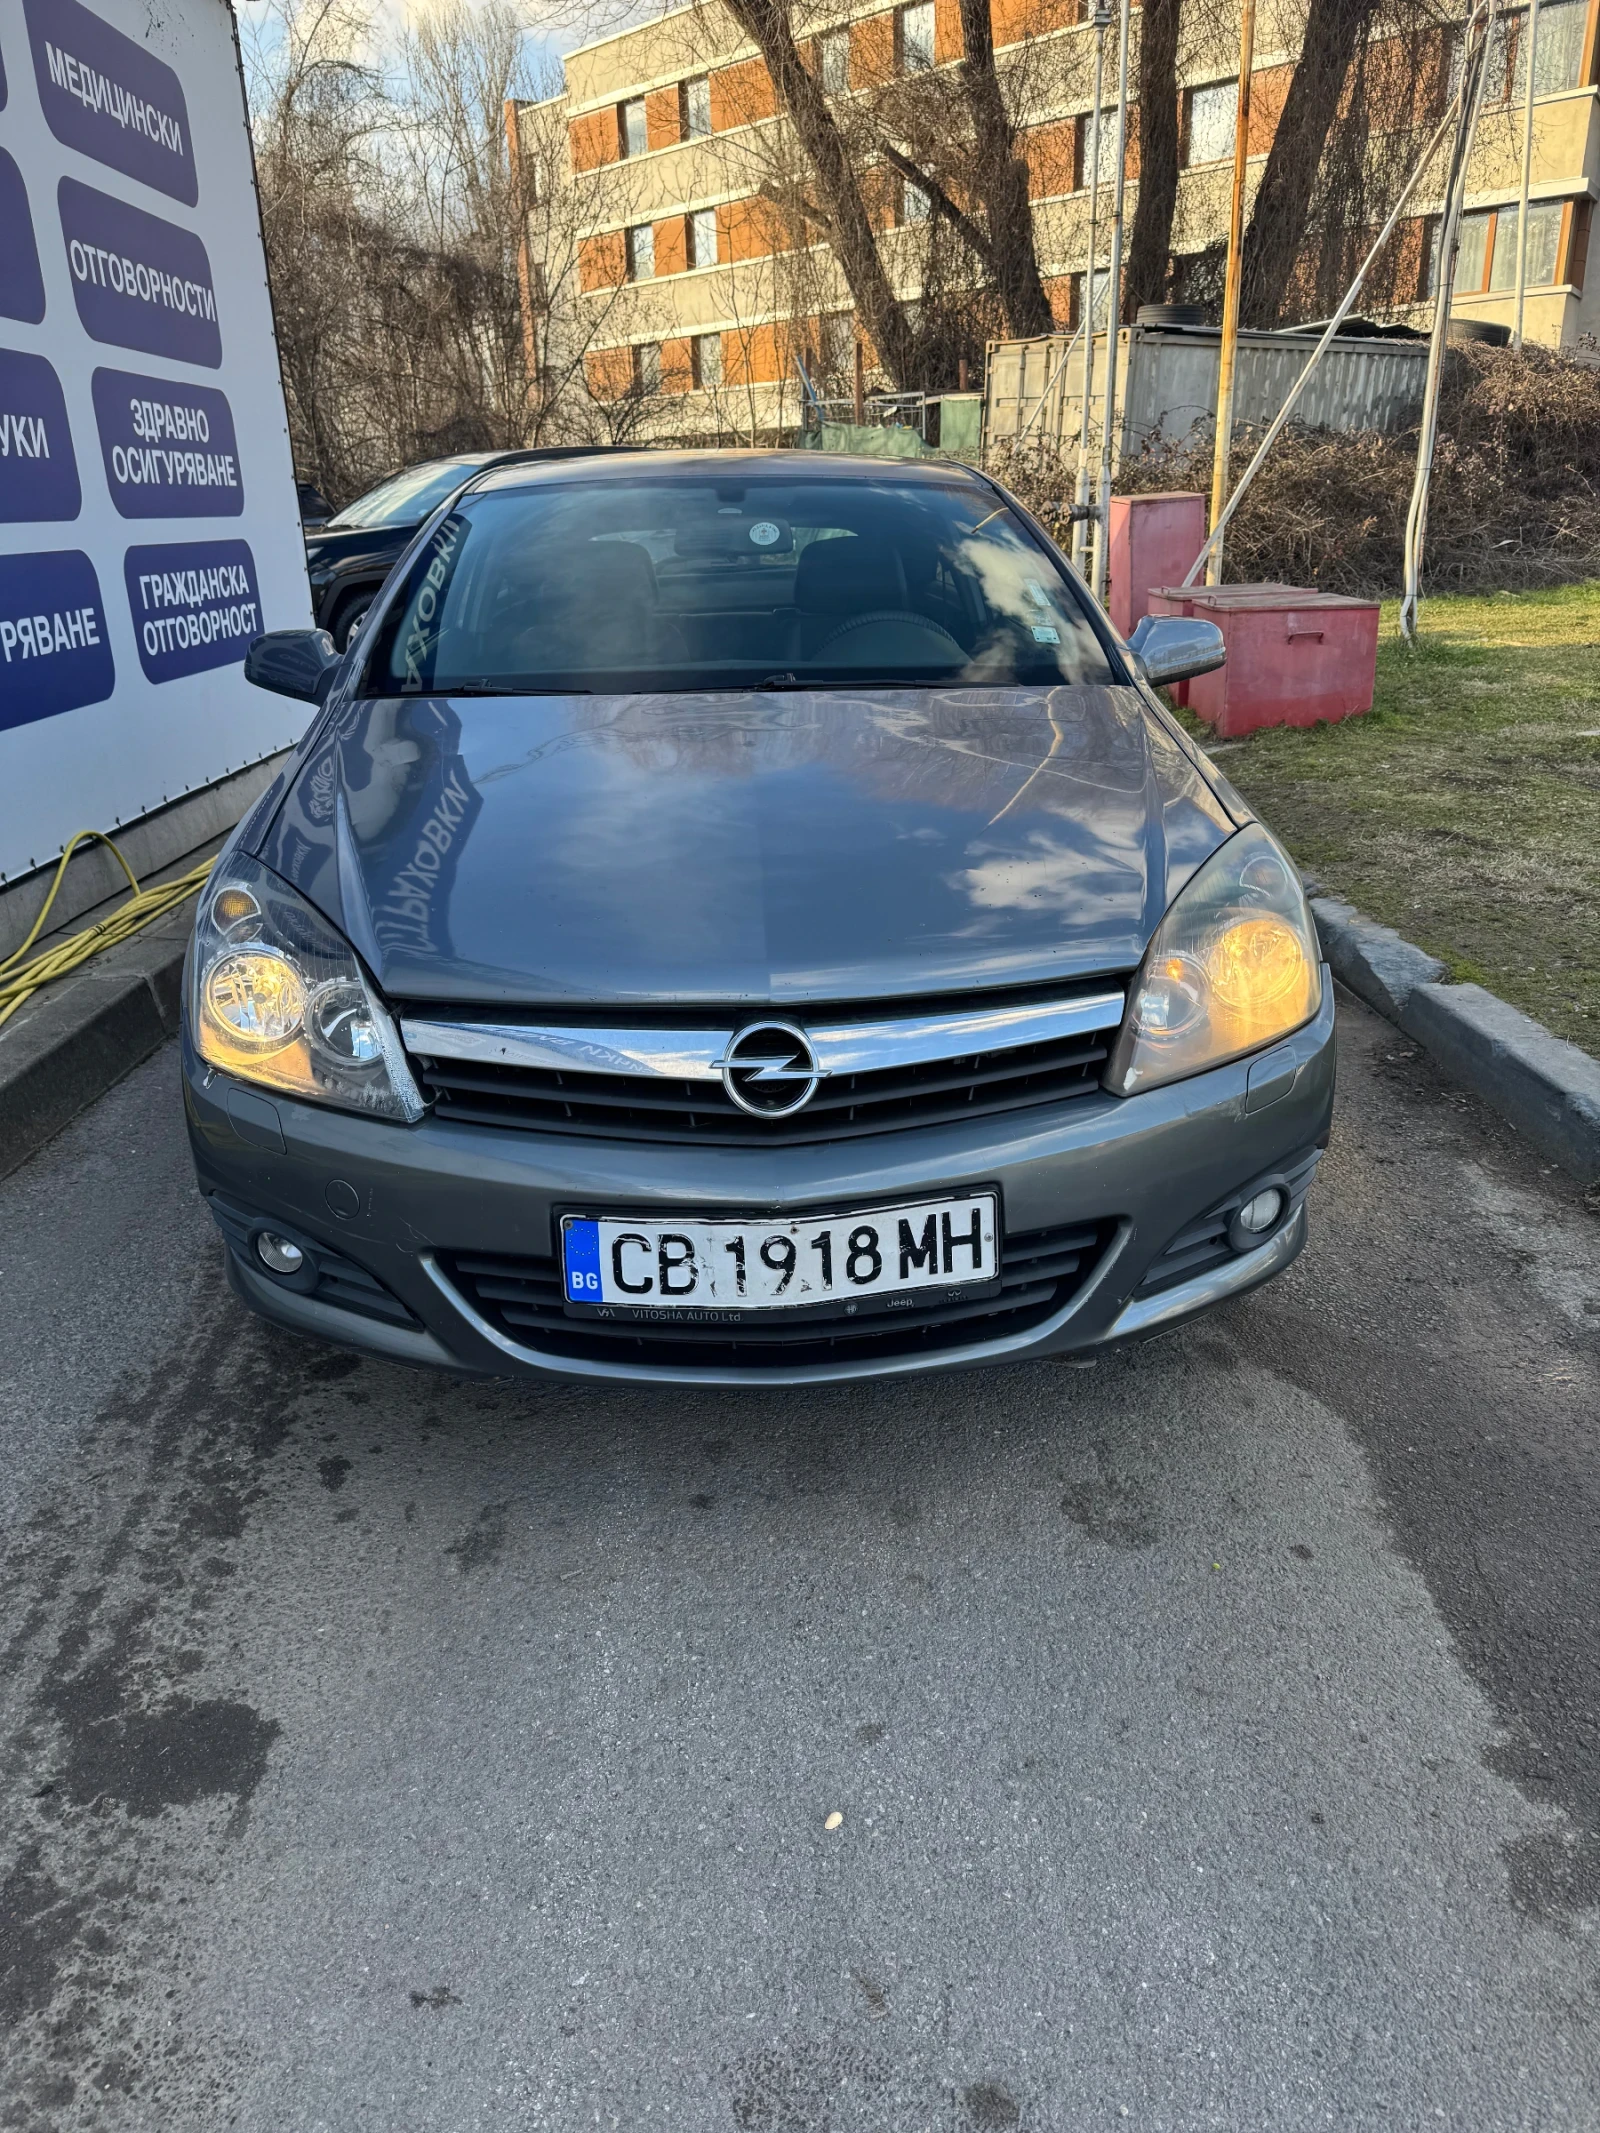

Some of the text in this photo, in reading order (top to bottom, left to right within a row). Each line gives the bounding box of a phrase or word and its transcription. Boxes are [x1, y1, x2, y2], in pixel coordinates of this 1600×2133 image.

[45, 41, 184, 156] МЕДИЦИНСКИ
[70, 239, 217, 322] ОТГОВОРНОСТИ
[130, 398, 210, 443] ЗДРАВНО
[112, 446, 238, 487] ОСИГУРЯВАНЕ
[139, 565, 250, 610] ГРАЖДАНСКА
[0, 607, 100, 662] РЯВАНЕ
[143, 603, 258, 656] ОТГОВОРНОСТ
[571, 1271, 599, 1290] BG
[724, 1225, 883, 1297] 1918
[632, 1309, 684, 1320] VITOSHA
[686, 1311, 719, 1321] AUTO
[887, 1298, 913, 1308] Jeep
